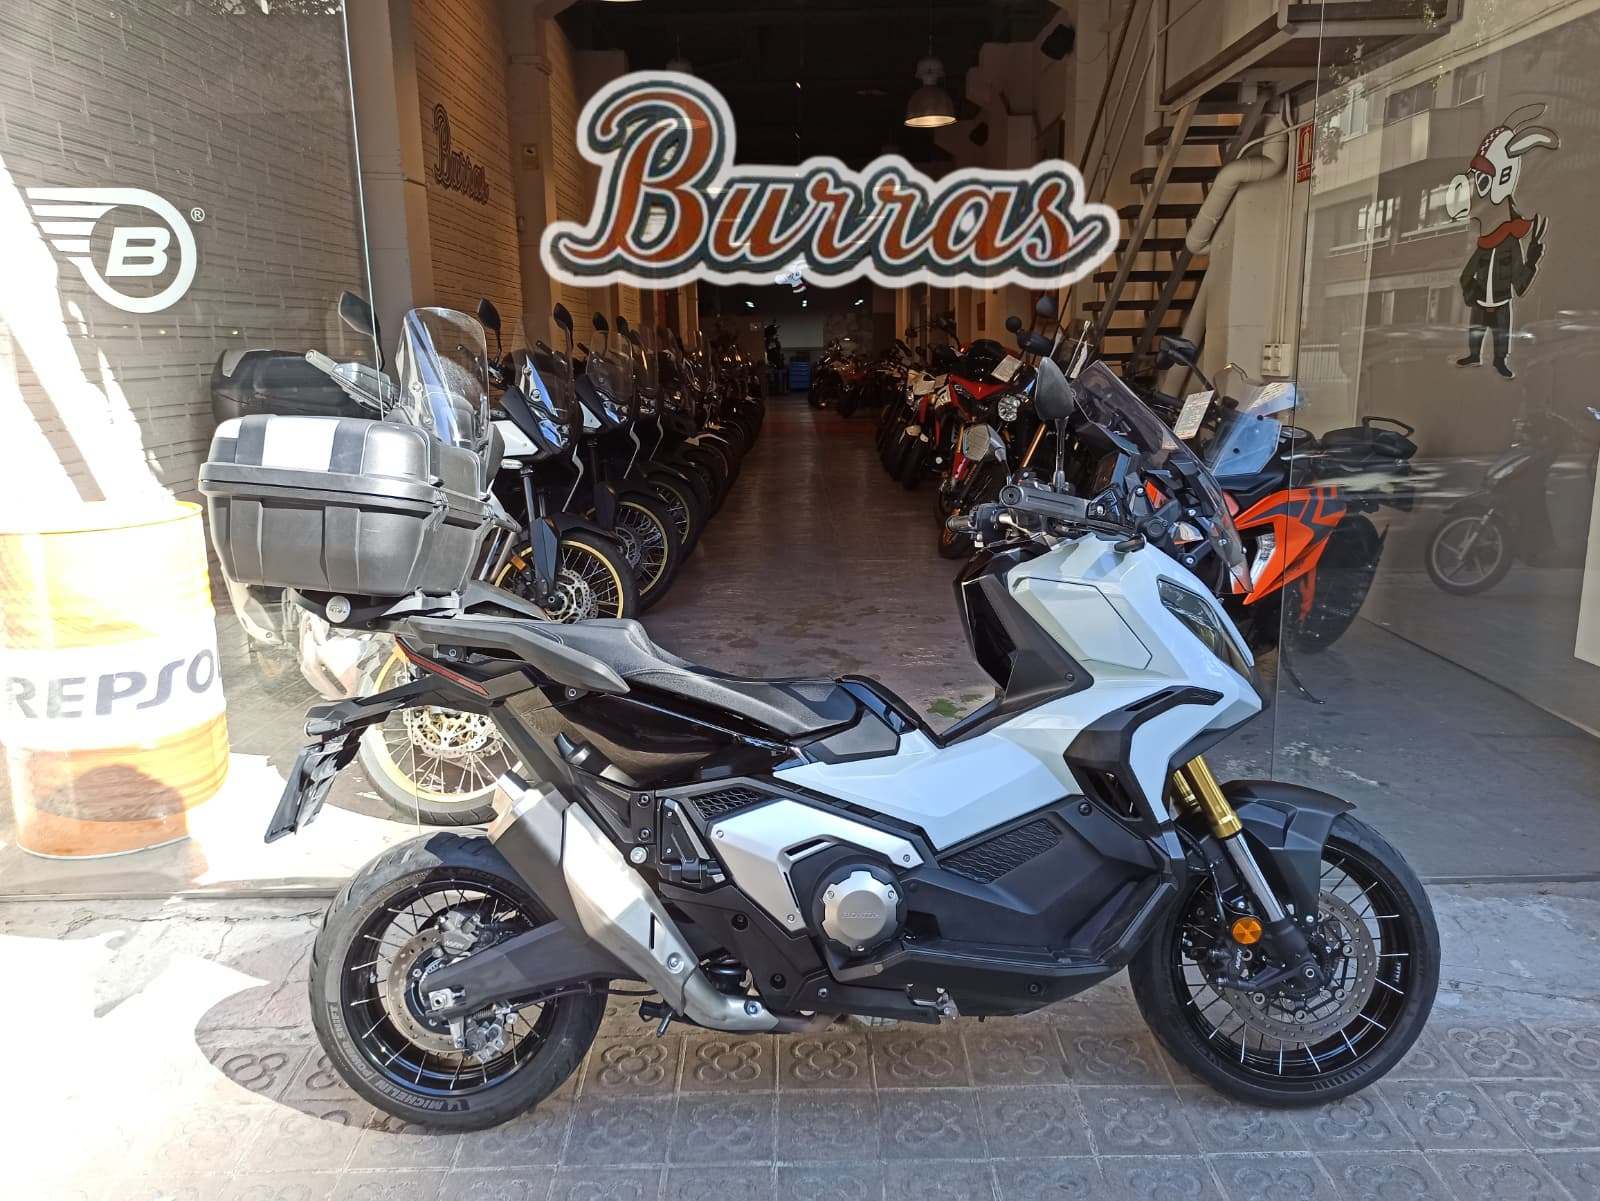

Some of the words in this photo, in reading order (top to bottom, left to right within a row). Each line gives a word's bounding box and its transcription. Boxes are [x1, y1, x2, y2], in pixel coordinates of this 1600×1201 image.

[433, 103, 490, 206] Burras
[549, 77, 1112, 279] Burras
[1499, 165, 1512, 185] B
[105, 227, 170, 276] B
[6, 648, 222, 719] REPSO
[374, 1077, 447, 1112] MICHELIN
